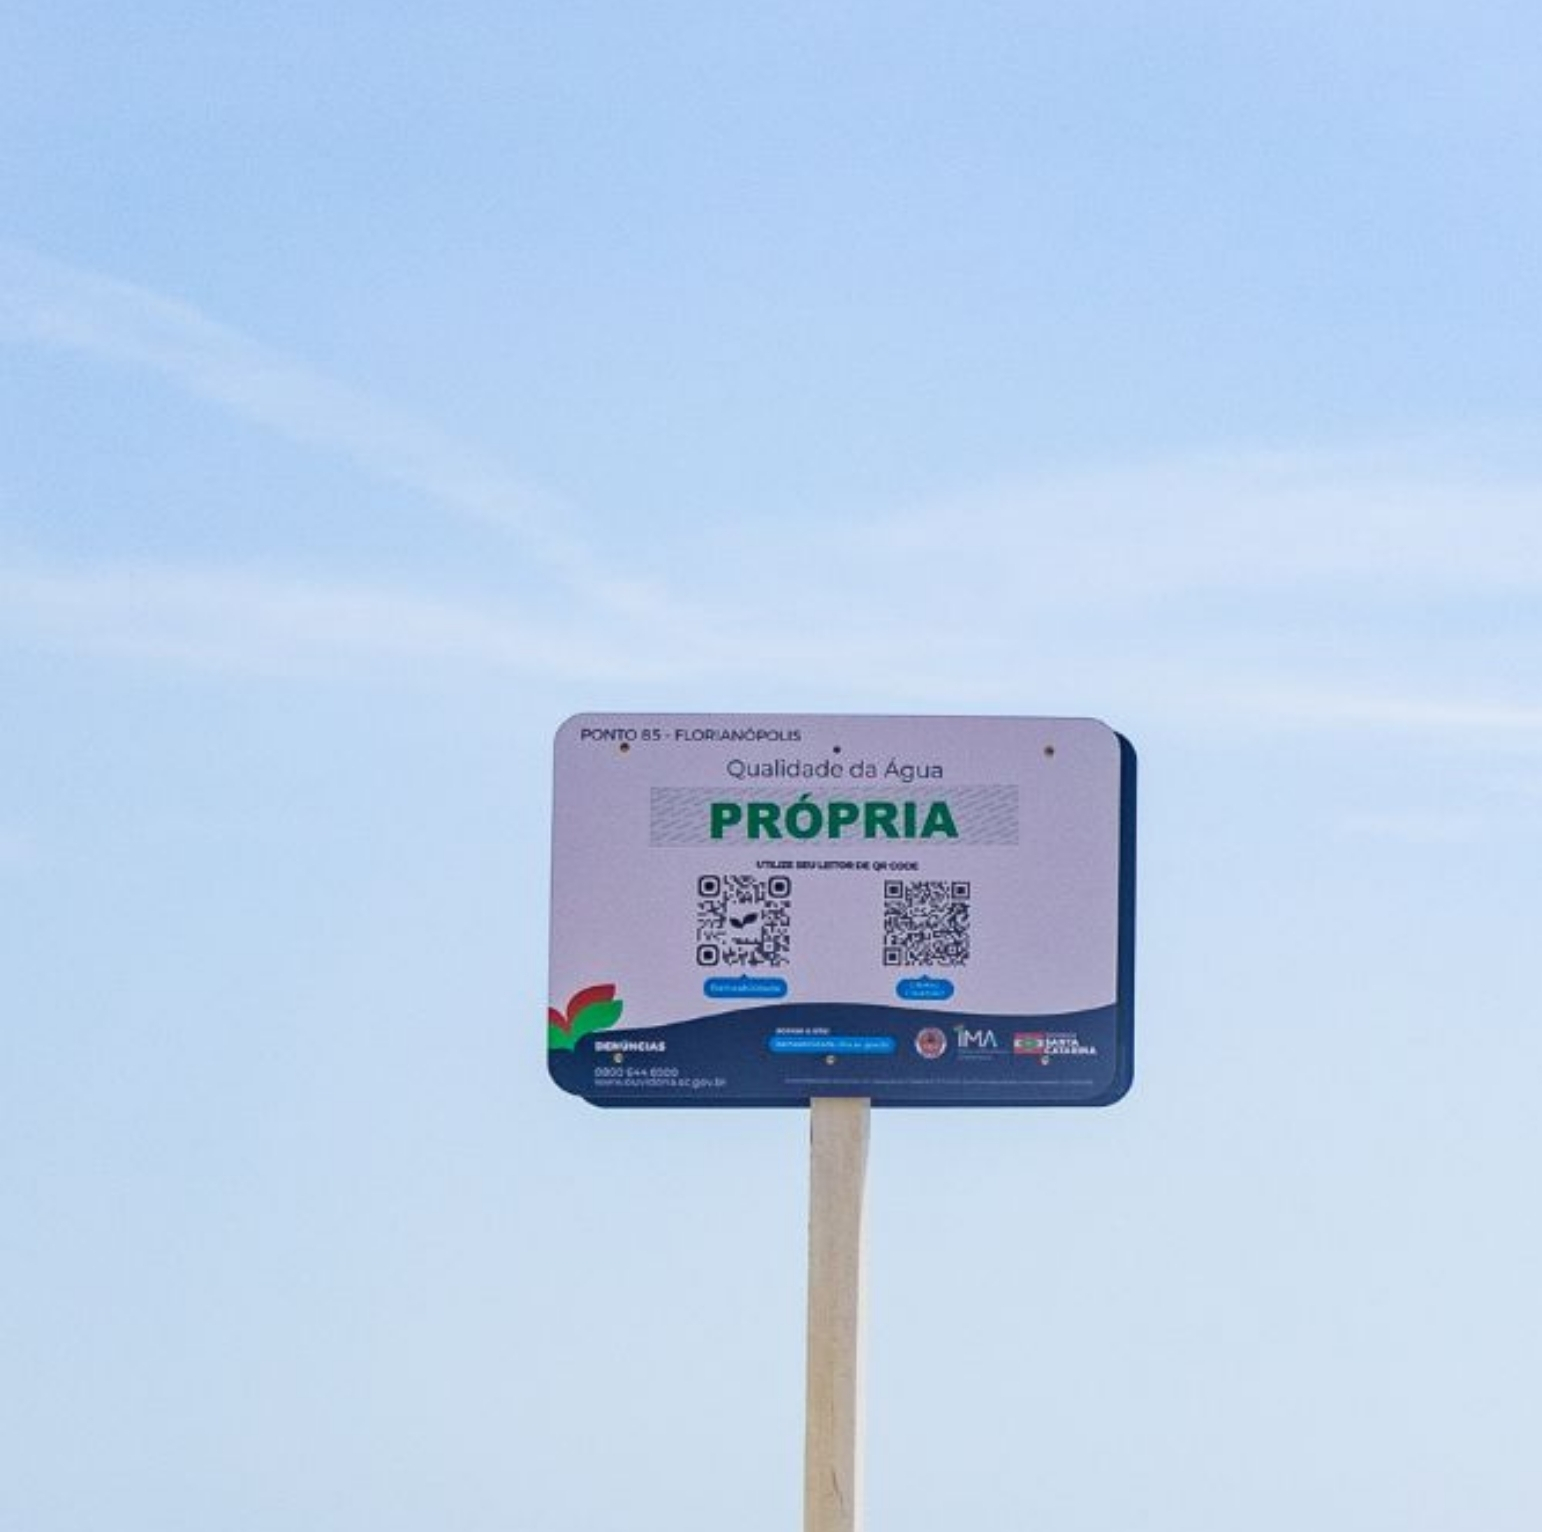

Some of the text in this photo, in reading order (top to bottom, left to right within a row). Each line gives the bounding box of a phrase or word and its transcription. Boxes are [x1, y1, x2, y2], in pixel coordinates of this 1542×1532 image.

[579, 728, 638, 742] PONTO
[640, 728, 661, 742] 85
[674, 725, 802, 743] FLORIANÓPOLIS
[727, 757, 944, 783] Qualidade da Água
[709, 793, 960, 840] PRÓPRIA
[594, 1039, 667, 1052] DENÚNCIAS
